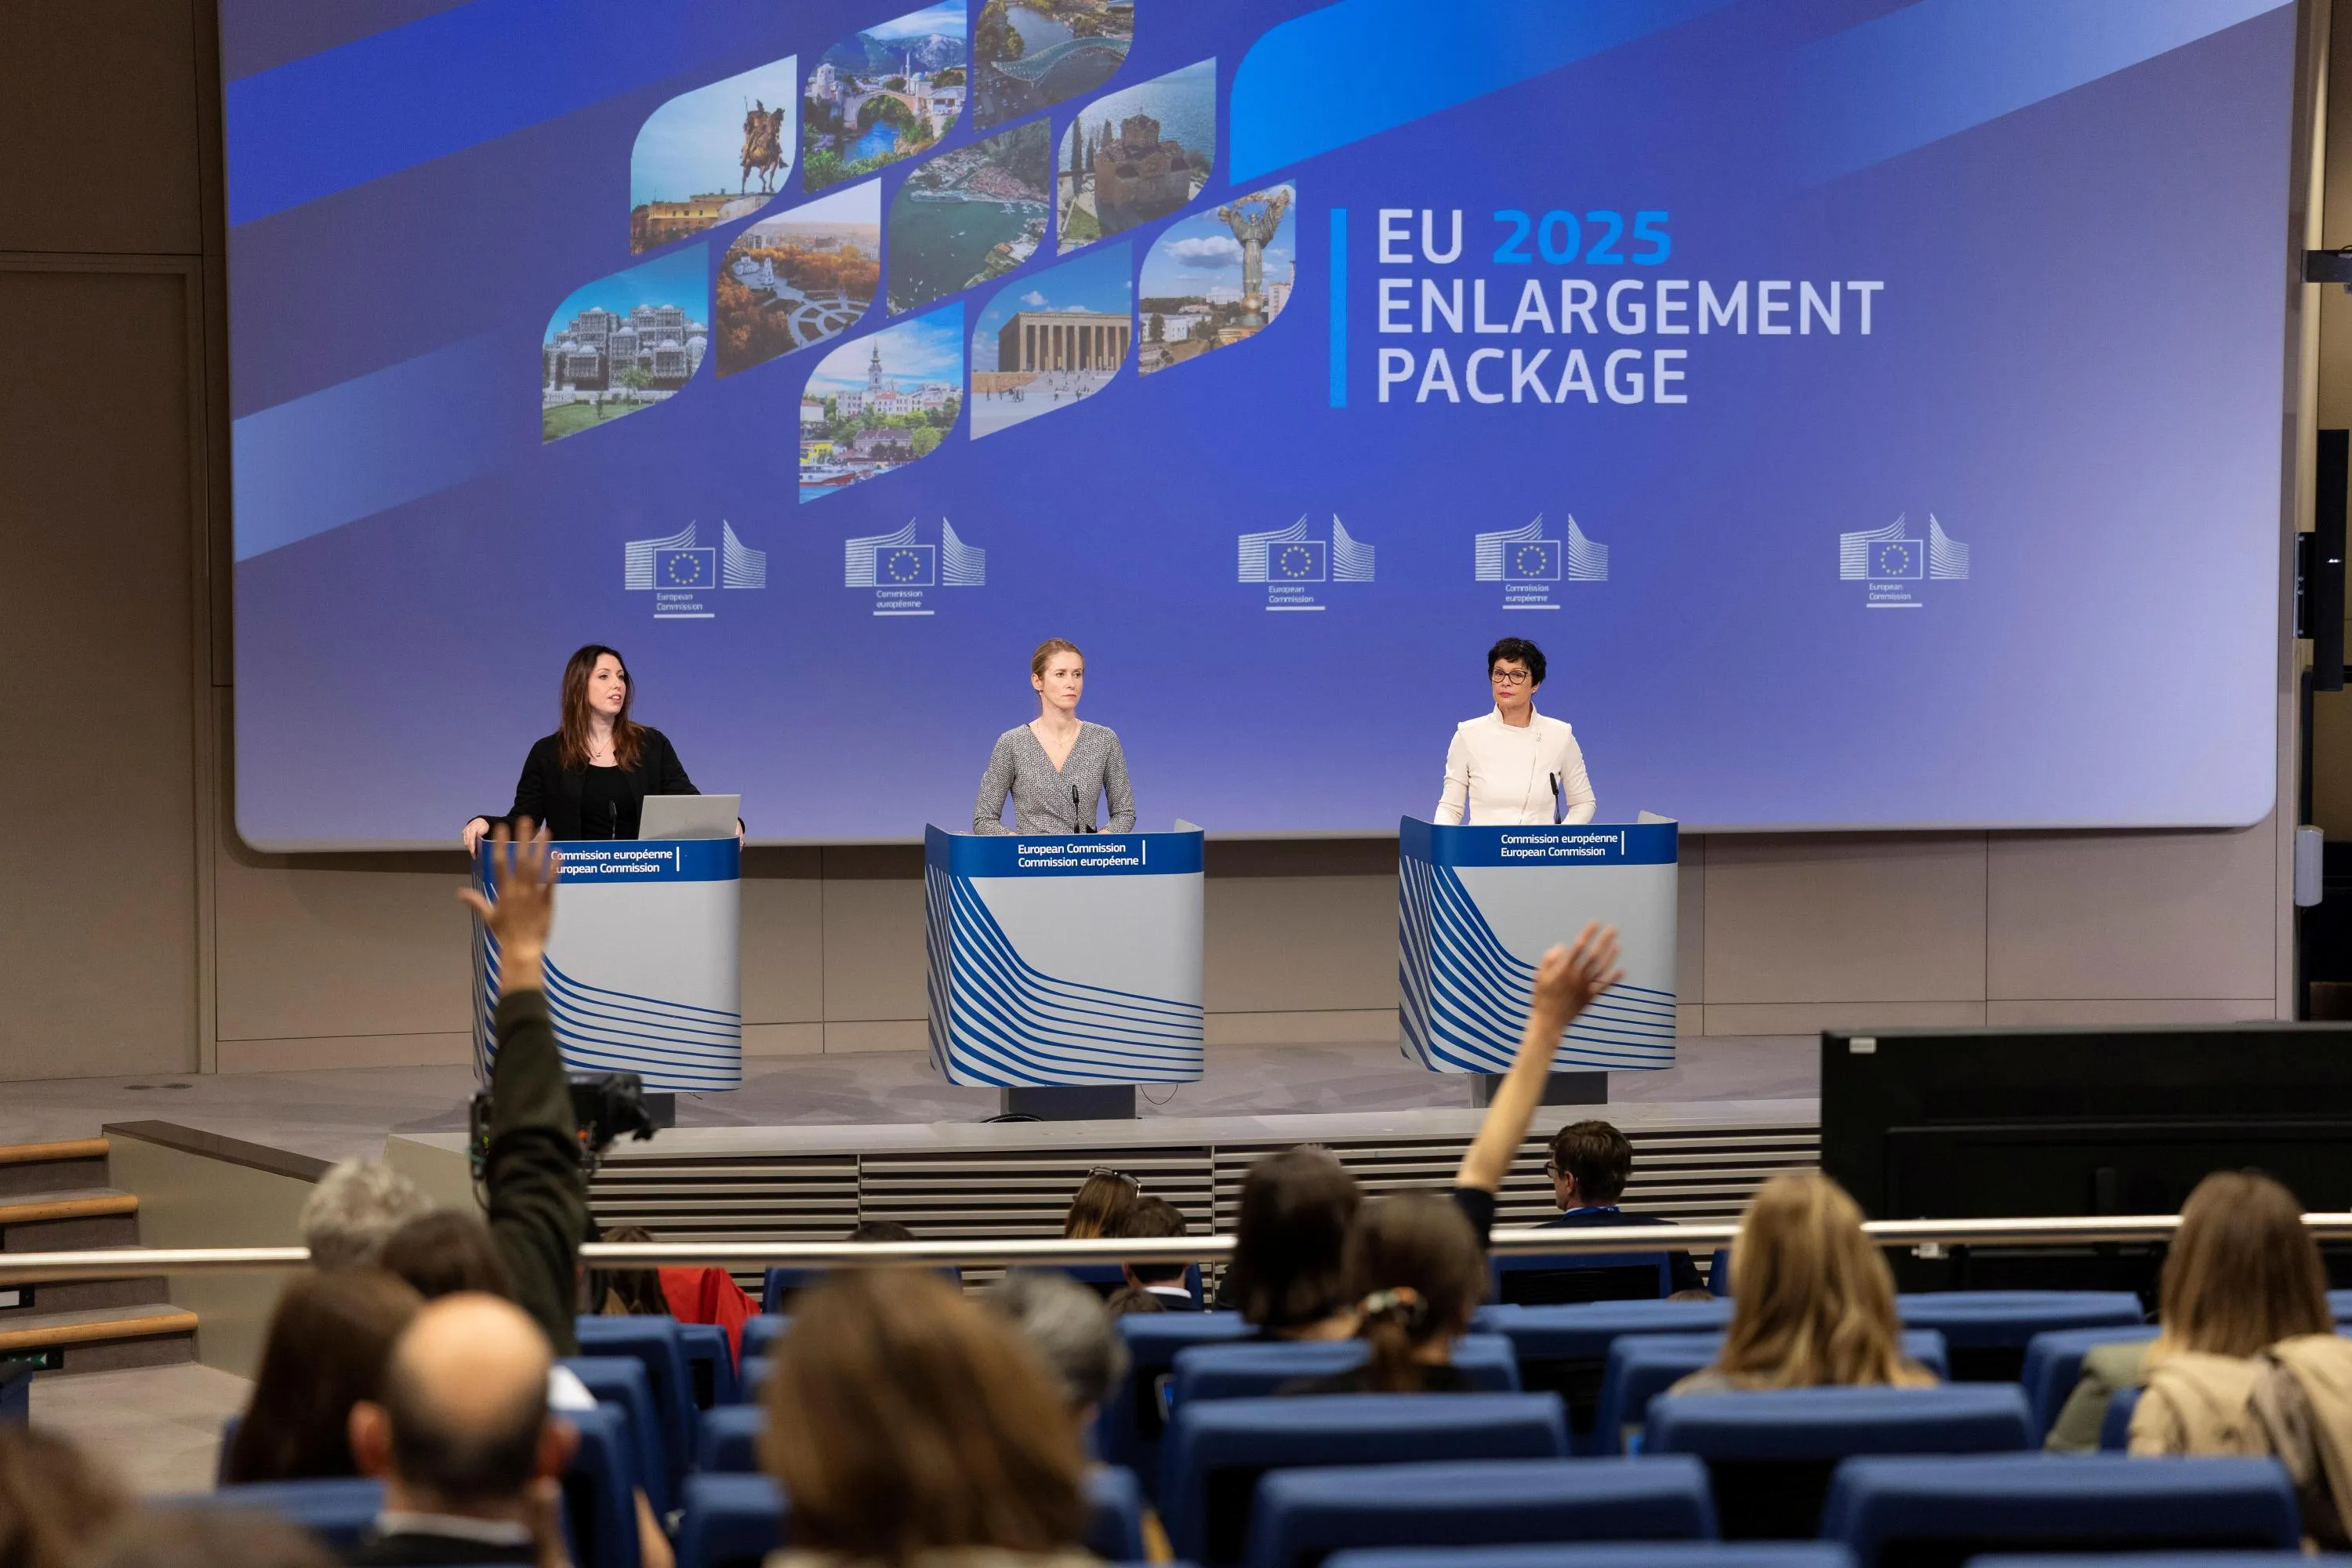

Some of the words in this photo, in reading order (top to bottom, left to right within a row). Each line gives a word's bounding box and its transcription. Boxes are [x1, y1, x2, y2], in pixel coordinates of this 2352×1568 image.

[1377, 209, 1463, 264] EU
[1493, 209, 1671, 266] 2025
[1377, 278, 1885, 335] ENLARGEMENT
[1377, 348, 1688, 404] PACKAGE
[877, 590, 923, 598] Commission
[1269, 586, 1305, 594] European
[657, 593, 693, 602] European
[1501, 834, 1559, 844] Commission
[1561, 833, 1618, 844] européenne
[551, 851, 611, 860] Commission
[613, 849, 673, 861] européenne
[1018, 844, 1064, 855] European
[1066, 843, 1126, 853] Commission
[1501, 848, 1546, 858] European
[1548, 847, 1606, 856] Commission
[1018, 857, 1078, 867] Commission
[1080, 855, 1139, 868] européenne
[552, 865, 597, 876] uropean
[600, 862, 660, 873] Commission
